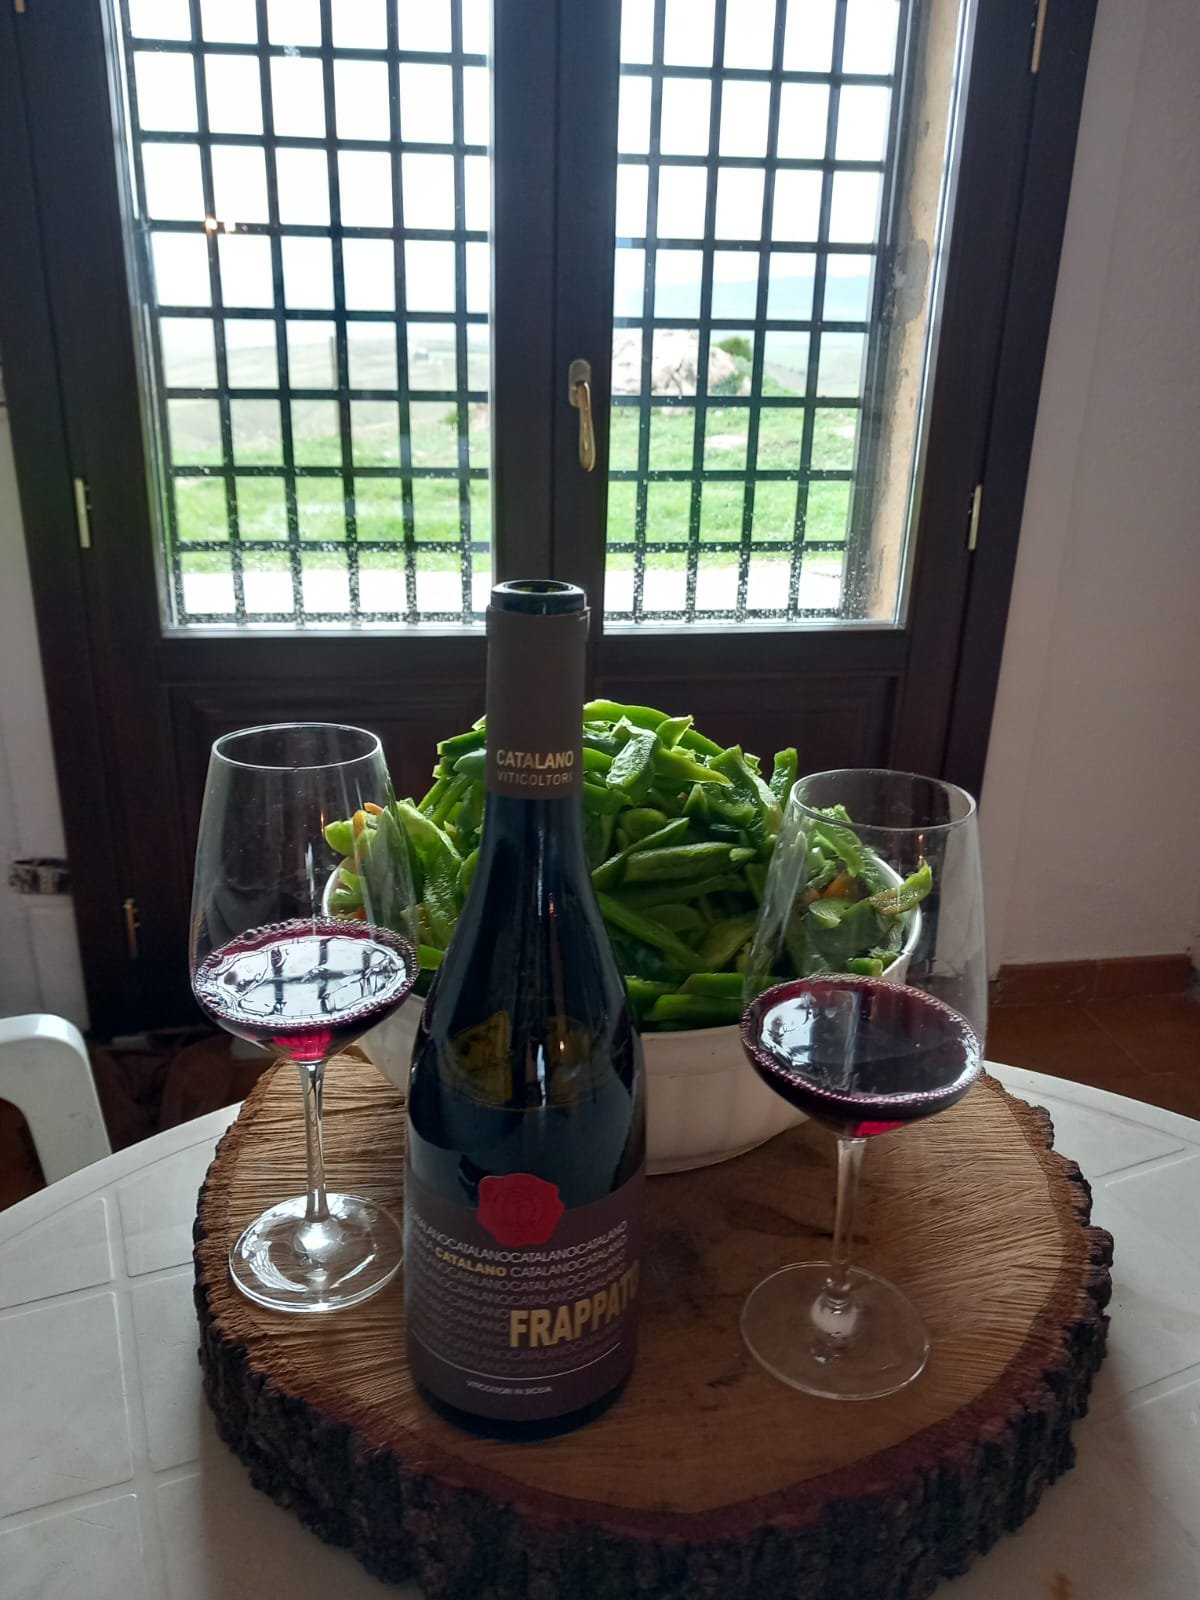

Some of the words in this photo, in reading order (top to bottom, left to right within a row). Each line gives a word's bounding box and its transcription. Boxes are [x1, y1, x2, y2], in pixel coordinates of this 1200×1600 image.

[496, 749, 574, 769] CATALANO
[497, 770, 572, 786] VITICOLTORI
[434, 1247, 507, 1277] CATALANO
